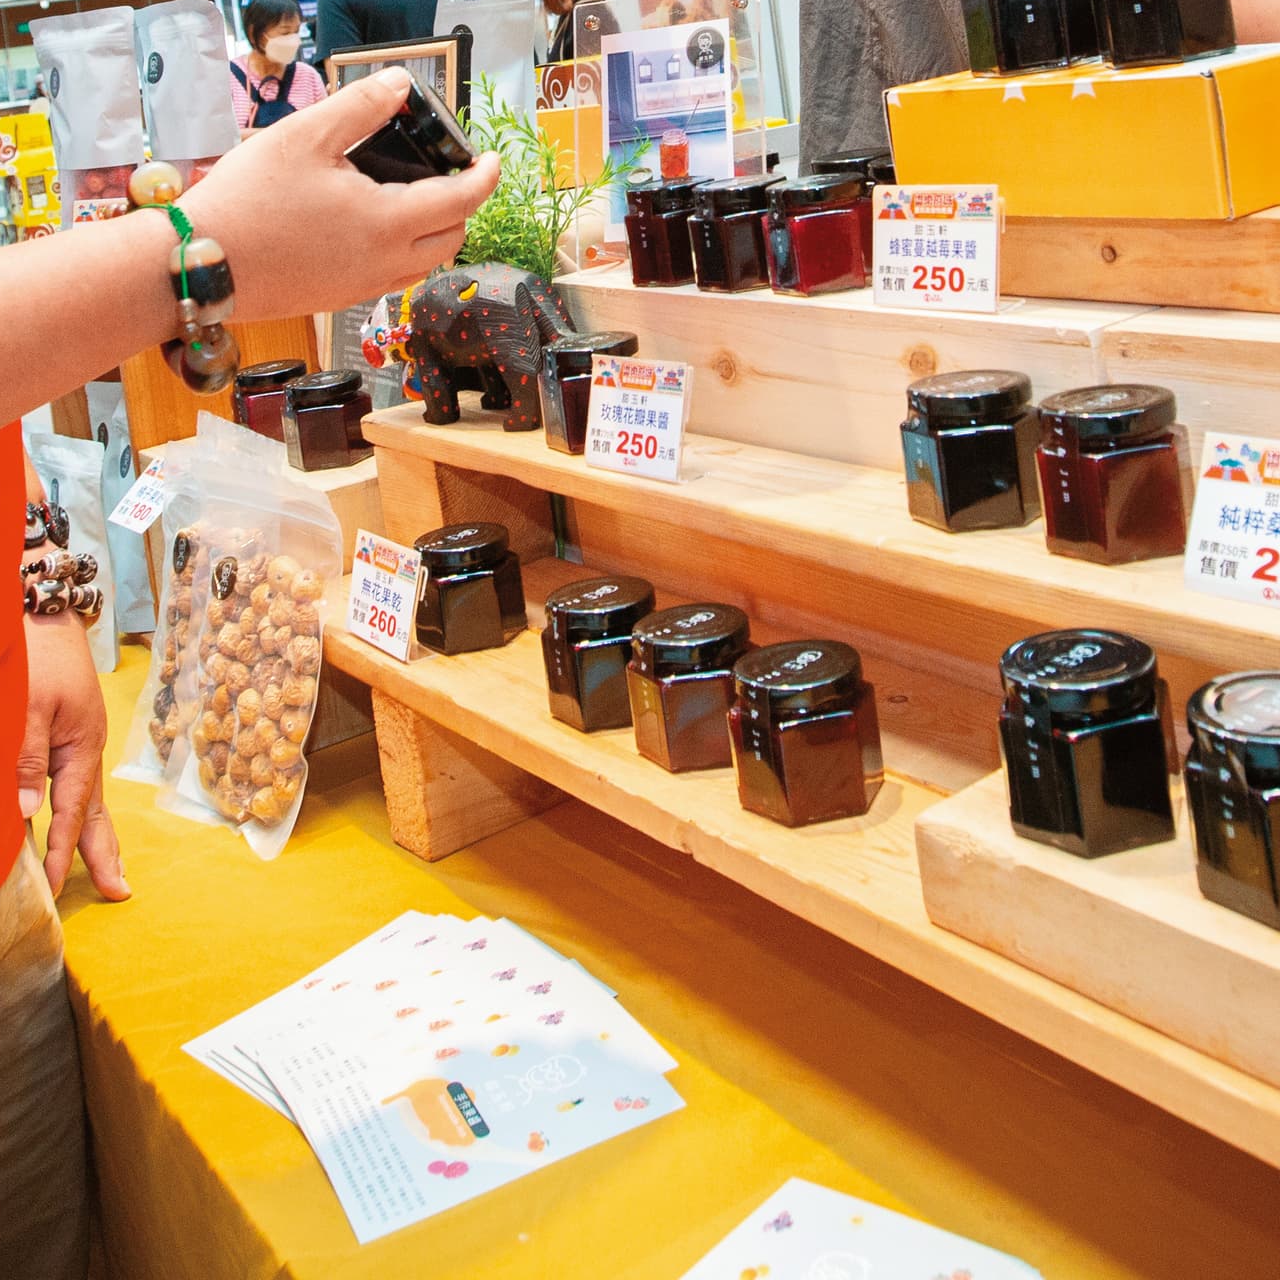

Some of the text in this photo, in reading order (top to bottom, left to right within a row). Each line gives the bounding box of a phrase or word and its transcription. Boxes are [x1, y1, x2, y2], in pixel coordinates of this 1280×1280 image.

[889, 238, 977, 260] 蜂蜜蔓越莓果醬
[912, 265, 965, 292] 250
[601, 403, 671, 430] 玫瑰花瓣果醬
[616, 430, 658, 459] 250
[129, 503, 152, 521] 180
[1200, 556, 1239, 581] 售價
[368, 605, 397, 638] 260
